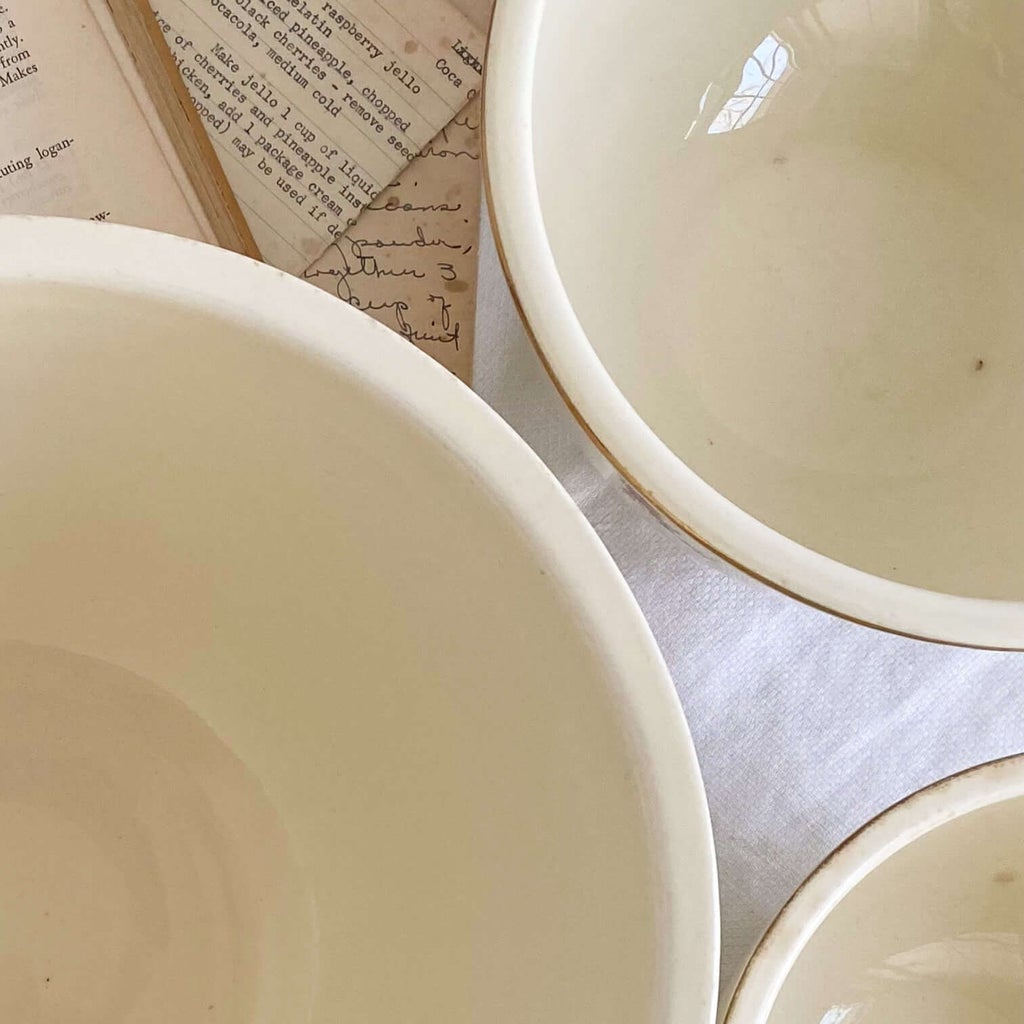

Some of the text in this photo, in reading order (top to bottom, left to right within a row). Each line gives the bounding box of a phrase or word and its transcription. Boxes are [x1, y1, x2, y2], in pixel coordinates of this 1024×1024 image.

[266, 47, 342, 118] medium cold
[273, 30, 327, 80] cherries
[342, 92, 384, 133] remove
[288, 21, 411, 134] pineapple, chopped
[321, 2, 383, 59] raspberry
[383, 52, 421, 94] jello
[435, 58, 462, 88] Coca
[35, 139, 74, 160] logan-
[175, 35, 336, 185] of cherries and pineapple
[210, 43, 240, 73] Make
[241, 74, 278, 108] jello
[280, 106, 291, 120] 1
[294, 122, 316, 143] cup
[320, 145, 338, 160] of
[217, 101, 343, 217] add 1 package cream
[436, 263, 457, 281] 3
